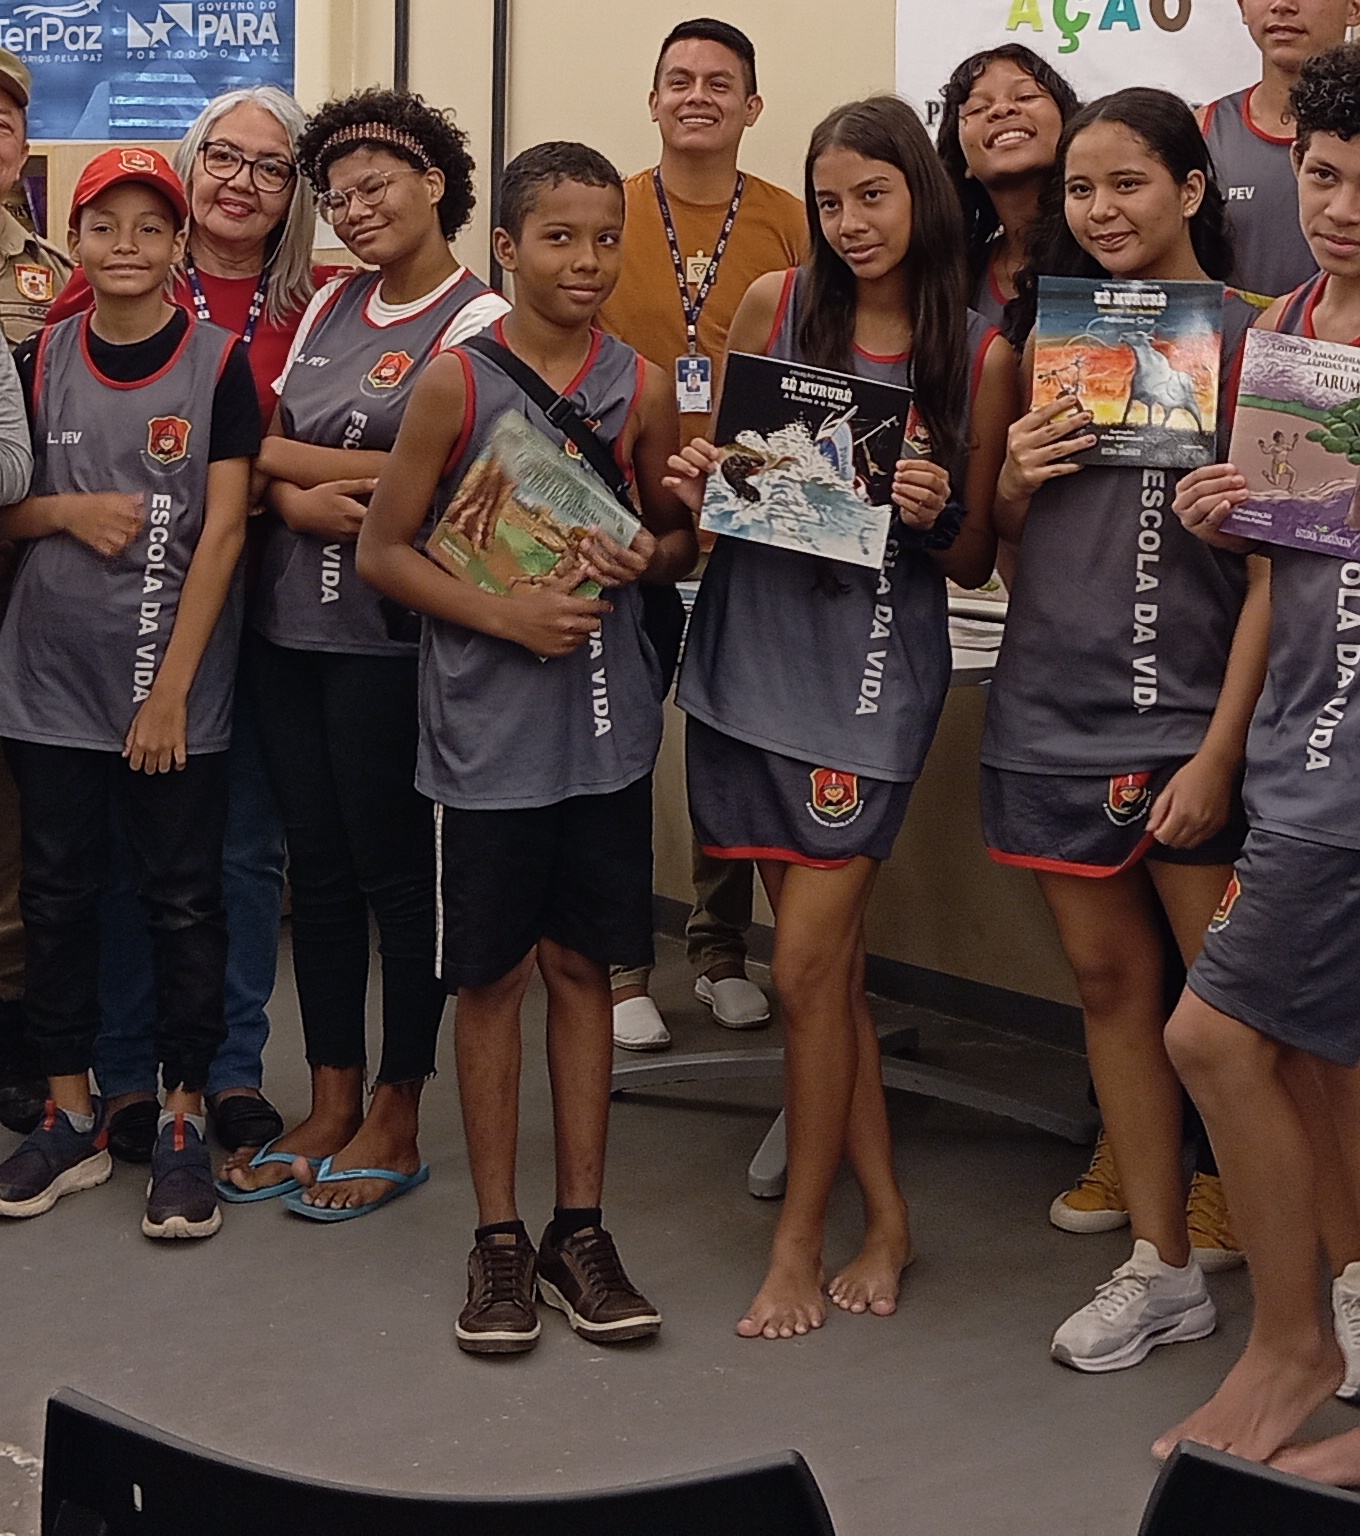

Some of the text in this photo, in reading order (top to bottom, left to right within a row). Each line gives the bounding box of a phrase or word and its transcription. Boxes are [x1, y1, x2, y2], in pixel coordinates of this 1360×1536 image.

[198, 1, 277, 11] GOVERNO DO
[198, 12, 280, 47] PARÁ
[54, 54, 80, 63] PELA
[83, 54, 104, 64] PAZ
[126, 52, 157, 61] POR
[165, 50, 210, 60] TODO
[220, 50, 229, 59] O
[1228, 187, 1255, 201] PEV
[781, 376, 798, 392] ZÉ
[799, 380, 853, 403] MURURÉ
[1136, 470, 1165, 592] ESCOLA
[320, 544, 341, 605] VIDA
[132, 494, 171, 703] ESCOLA DA VIDA
[870, 604, 893, 639] DA
[1133, 603, 1158, 643] DA
[855, 650, 887, 715] VIDA
[589, 668, 613, 738] VIDA
[1305, 696, 1349, 771] VIDA
